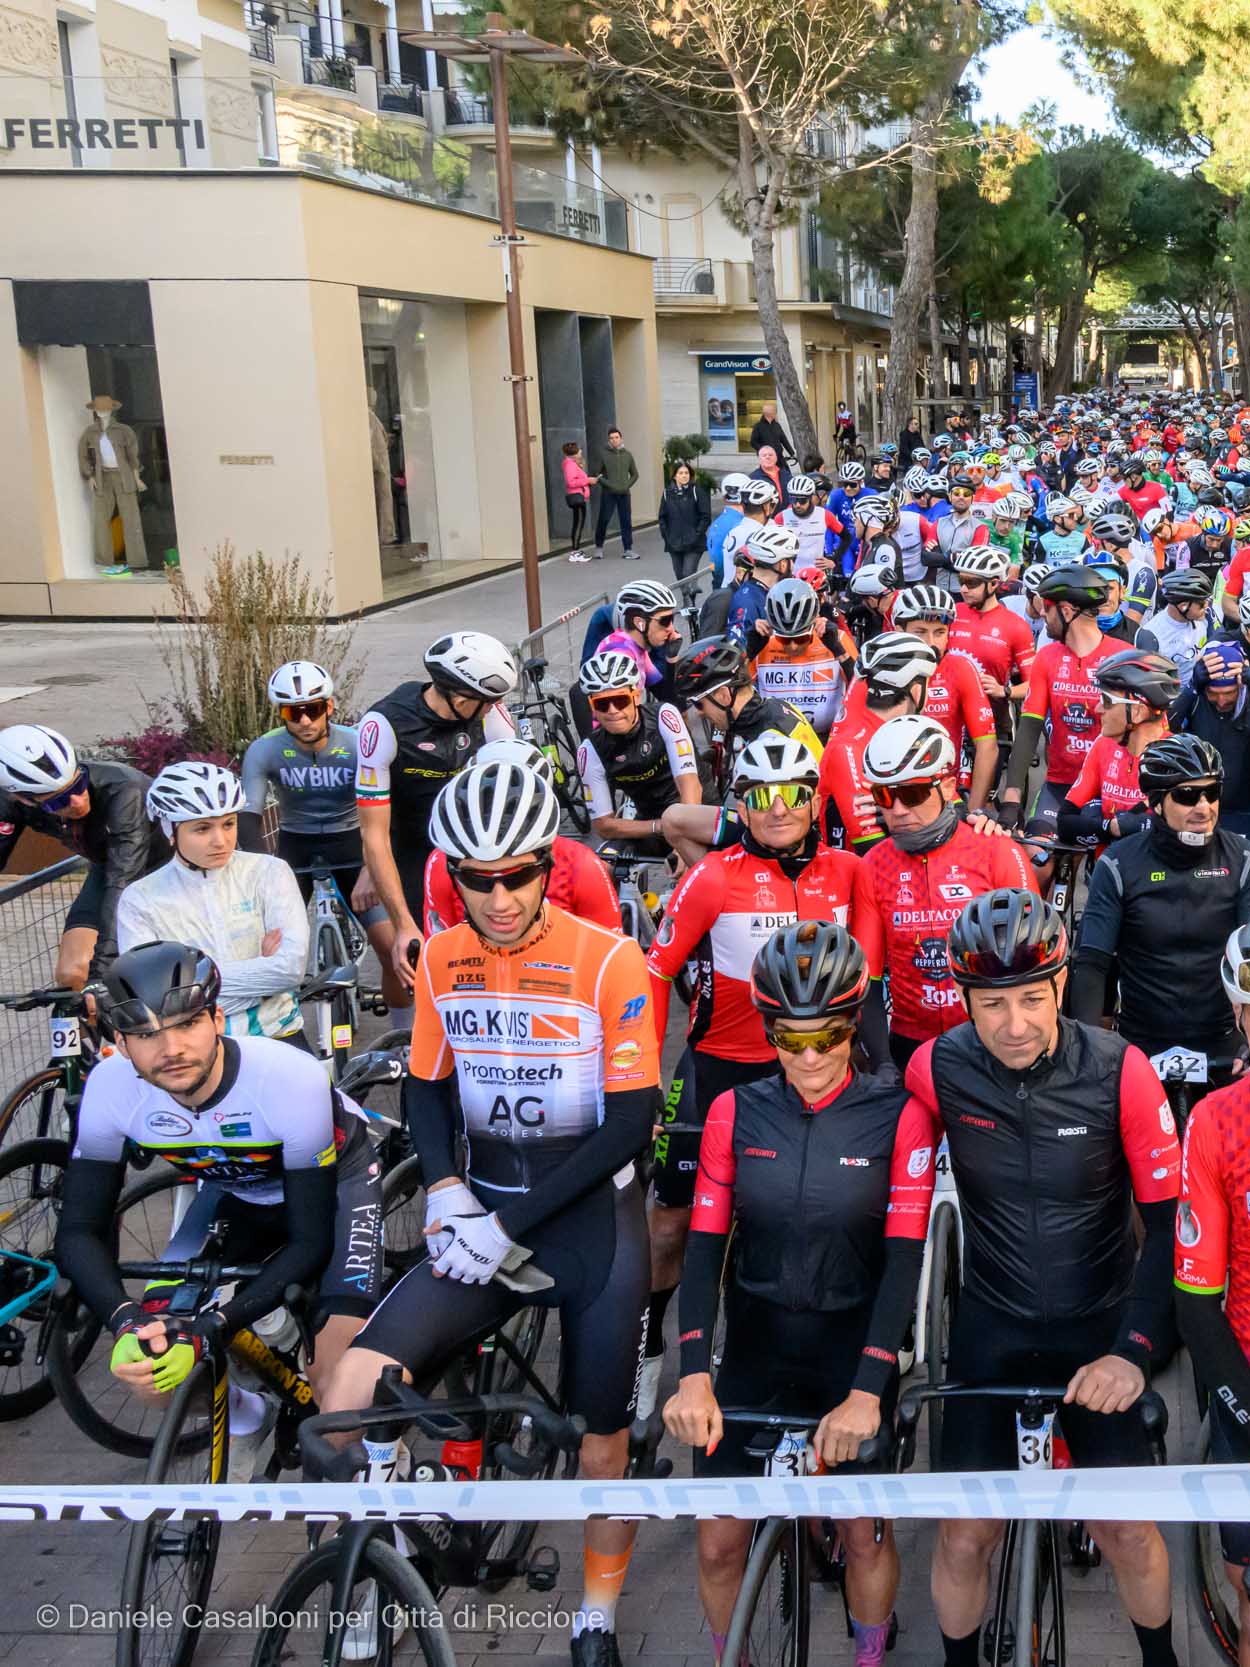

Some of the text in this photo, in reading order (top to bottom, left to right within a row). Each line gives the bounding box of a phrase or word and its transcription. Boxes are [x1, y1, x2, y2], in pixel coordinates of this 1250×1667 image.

[4, 118, 205, 149] FERRETTI
[562, 205, 601, 235] FERRETTI
[704, 359, 749, 369] GrandVision
[219, 454, 274, 465] FERRETTI
[455, 664, 478, 682] LAZER
[279, 767, 355, 790] MYBIKE
[922, 985, 960, 1007] Top
[53, 1030, 77, 1049] 92
[505, 1039, 581, 1047] ENERGETICO
[463, 1060, 563, 1081] Promotech
[487, 1095, 545, 1128] AG
[343, 1203, 377, 1293] ARTEA
[1176, 1269, 1208, 1285] FORMA
[626, 1306, 650, 1410] Promotech
